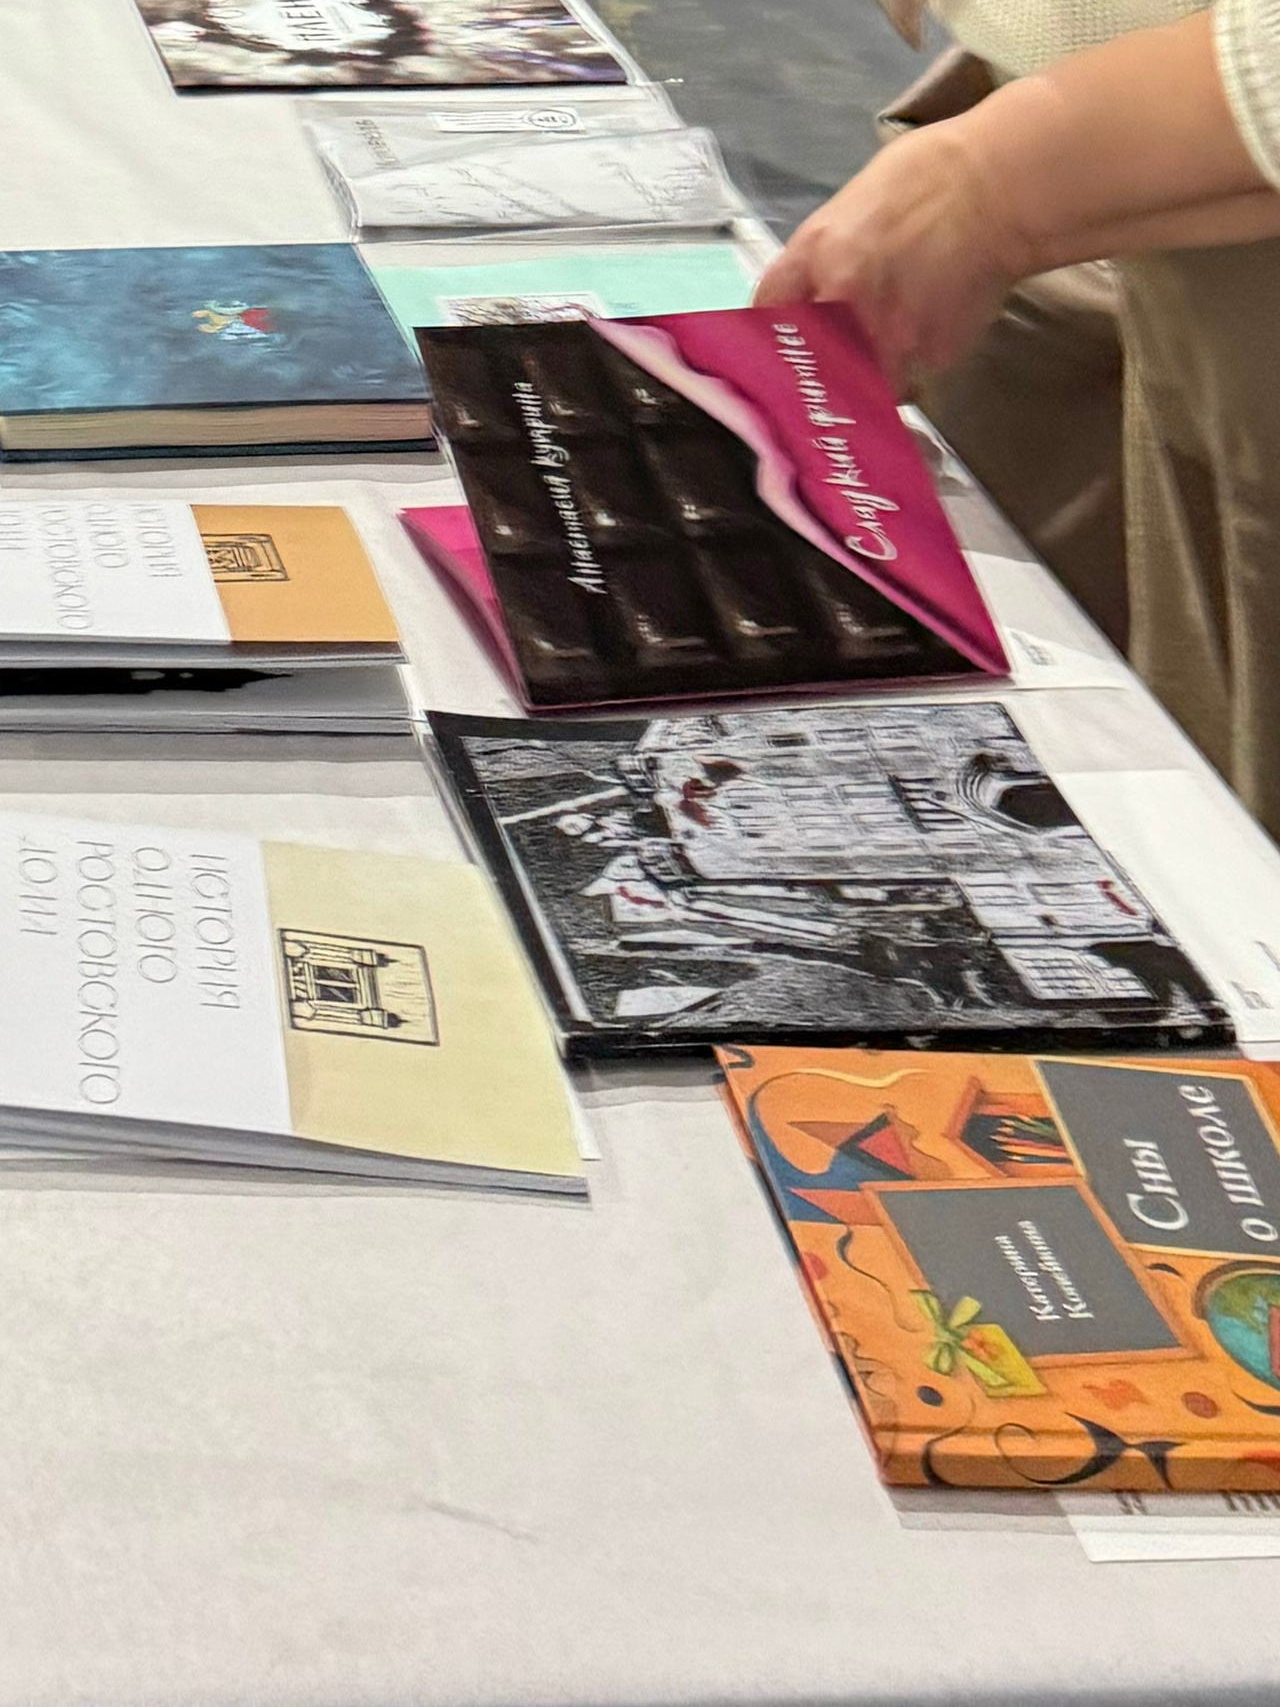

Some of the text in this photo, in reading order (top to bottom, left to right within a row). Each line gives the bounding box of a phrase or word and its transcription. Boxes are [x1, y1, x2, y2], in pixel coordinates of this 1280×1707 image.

[75, 840, 122, 1105] РОСТОВСКОГО
[131, 846, 179, 985] ОДНОГО
[189, 853, 241, 1010] ИСТОРИЯ
[1122, 1138, 1190, 1231] Сны
[1176, 1084, 1265, 1207] школе
[993, 1234, 1062, 1321] Катерина
[1239, 1218, 1279, 1242] о
